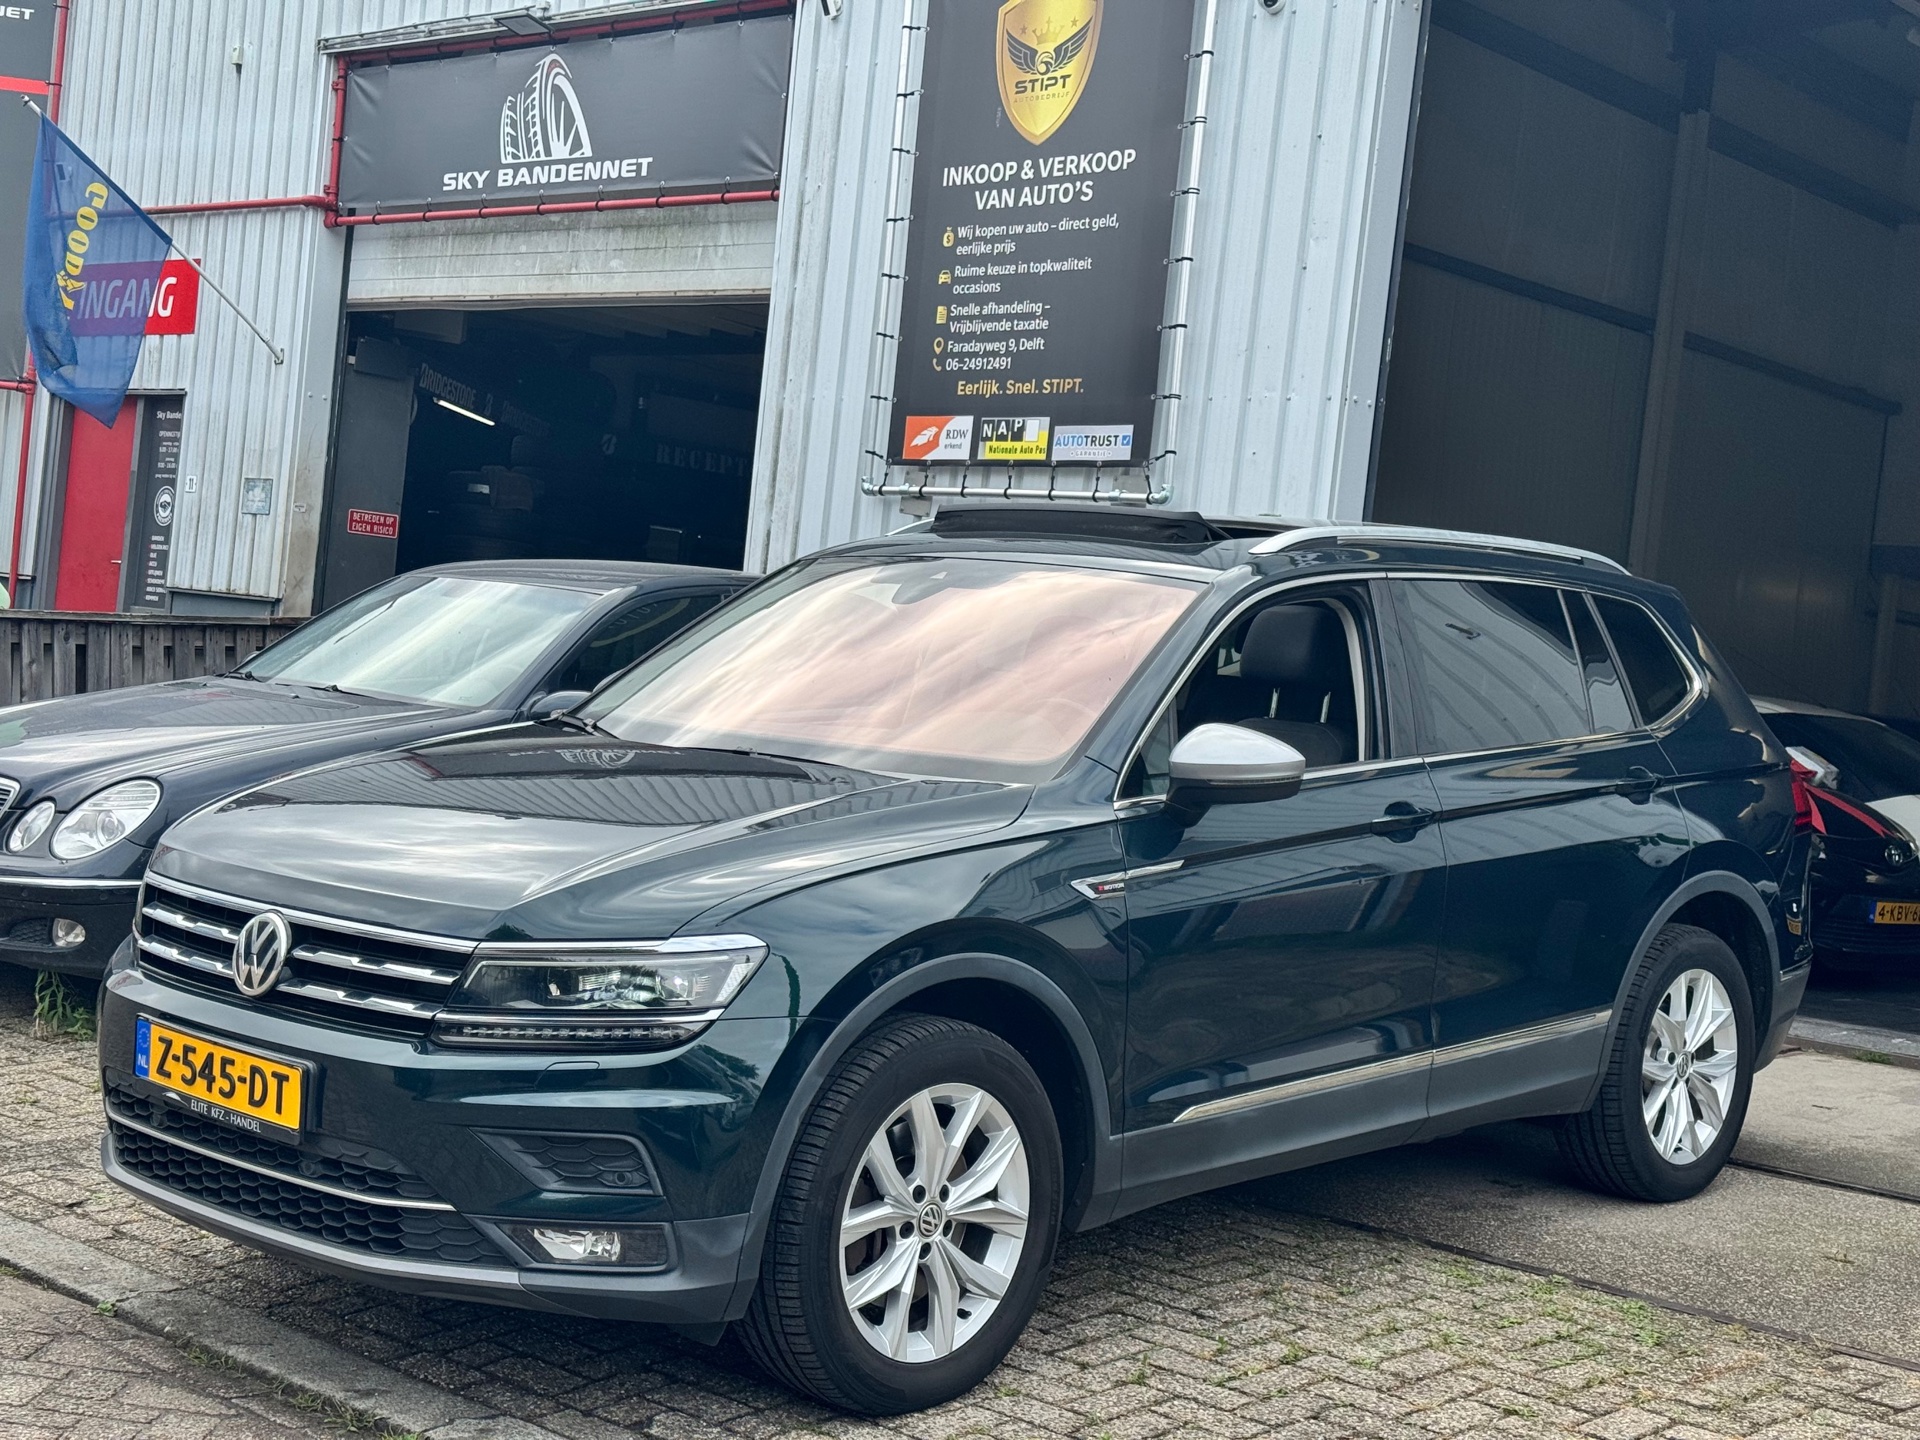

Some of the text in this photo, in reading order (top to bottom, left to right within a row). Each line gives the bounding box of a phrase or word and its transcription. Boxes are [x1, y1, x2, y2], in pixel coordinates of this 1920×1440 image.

[1014, 74, 1072, 94] STIPT
[1013, 91, 1070, 103] AUTOBEDRIJF
[442, 157, 653, 191] SKY BANDENNET
[942, 149, 1136, 187] INKOOP & VERKOOP
[975, 188, 1015, 210] VAN
[957, 225, 973, 240] Wij
[975, 223, 1006, 240] kopen
[1009, 224, 1024, 235] uw
[1025, 220, 1049, 234] auto
[1058, 216, 1089, 231] direct
[1091, 213, 1119, 231] geld,
[956, 239, 1016, 256] eerlijke prijs
[954, 256, 1092, 277] Ruime keuze in topkwaliteit
[953, 281, 1001, 294] occasions
[77, 276, 177, 320] INGANG
[950, 302, 980, 316] Snelle
[981, 300, 1043, 315] afhandeling
[949, 316, 1049, 335] Vrijblijvende taxatie
[947, 337, 1045, 354] Faradayweg 9, Delft
[419, 362, 477, 409] BRIDGESTONE
[957, 378, 1084, 398] Eerlijk. Snel. STIPT.
[945, 429, 969, 440] RDW
[1054, 434, 1119, 447] AUTOTRUST
[944, 442, 962, 450] erkend
[988, 445, 1046, 454] Nationale Auto Pas
[352, 512, 395, 525] BETREDEN OP
[351, 522, 394, 535] EIGEN RISICO
[137, 1053, 148, 1069] NL
[156, 1035, 290, 1115] Z-545-DT
[190, 1099, 208, 1115] ELITE
[211, 1106, 225, 1121] KFZ
[230, 1112, 261, 1133] HANDEL
